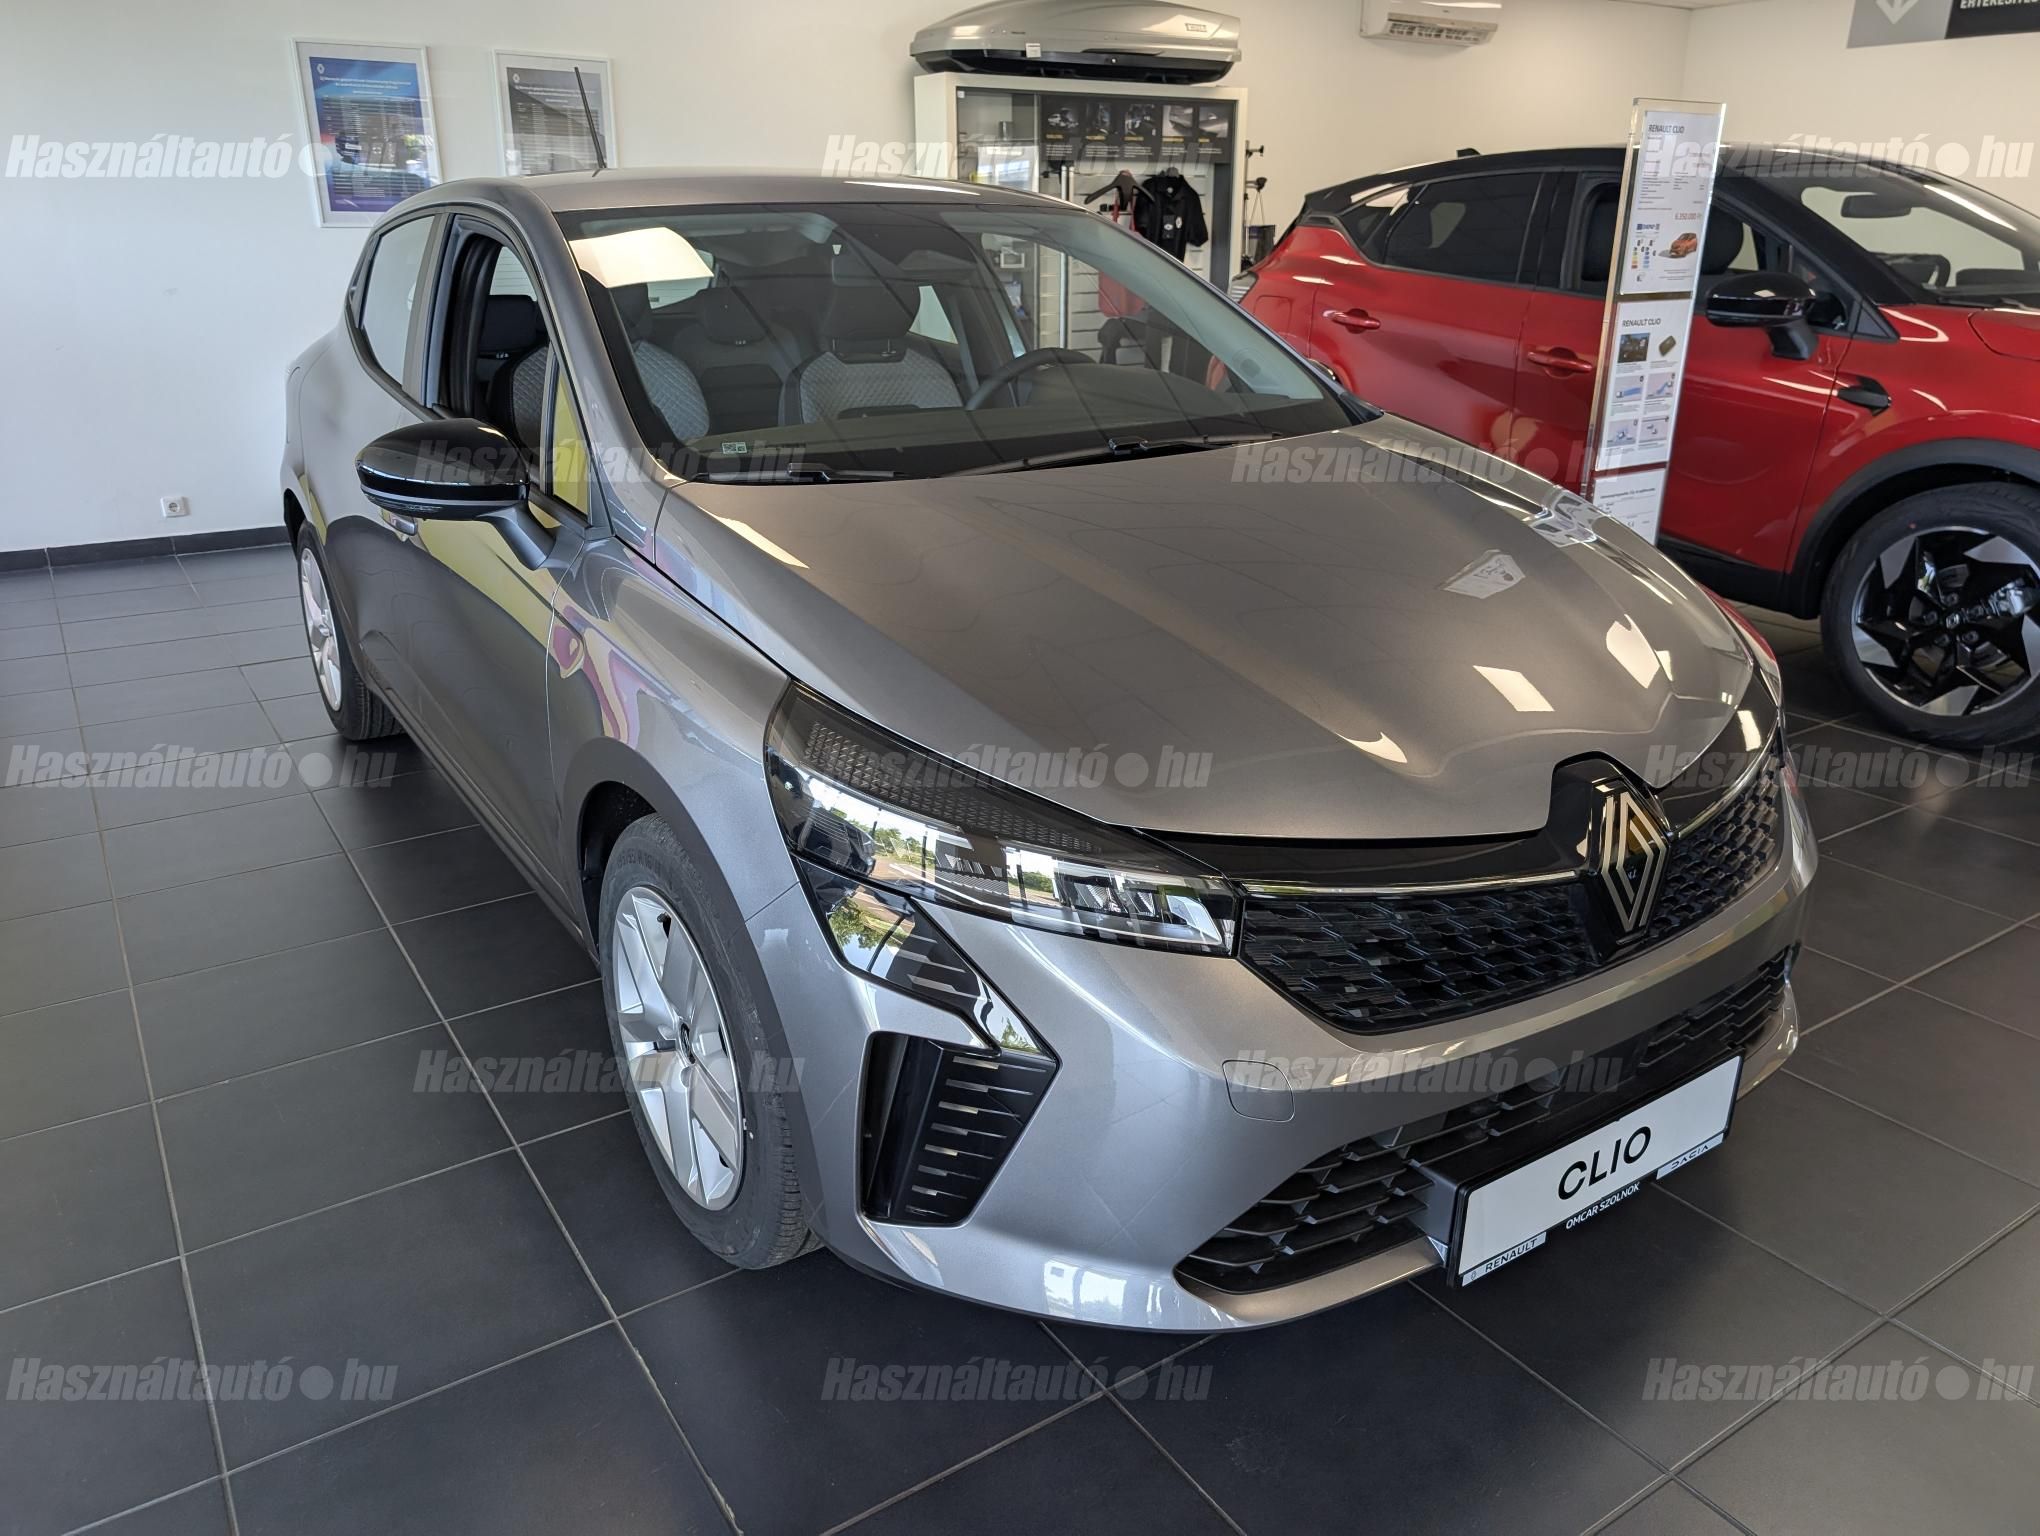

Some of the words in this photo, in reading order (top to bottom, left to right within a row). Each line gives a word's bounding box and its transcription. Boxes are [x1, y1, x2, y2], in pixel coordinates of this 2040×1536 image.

[1622, 319, 1647, 327] RENAULT
[1647, 318, 1661, 326] CLIO
[1558, 1126, 1651, 1200] CLIO
[1671, 1145, 1709, 1169] DACIA
[1566, 1205, 1600, 1230] OMCAR
[1599, 1181, 1640, 1212] SZOLNOK
[1485, 1238, 1538, 1273] RENAULT
